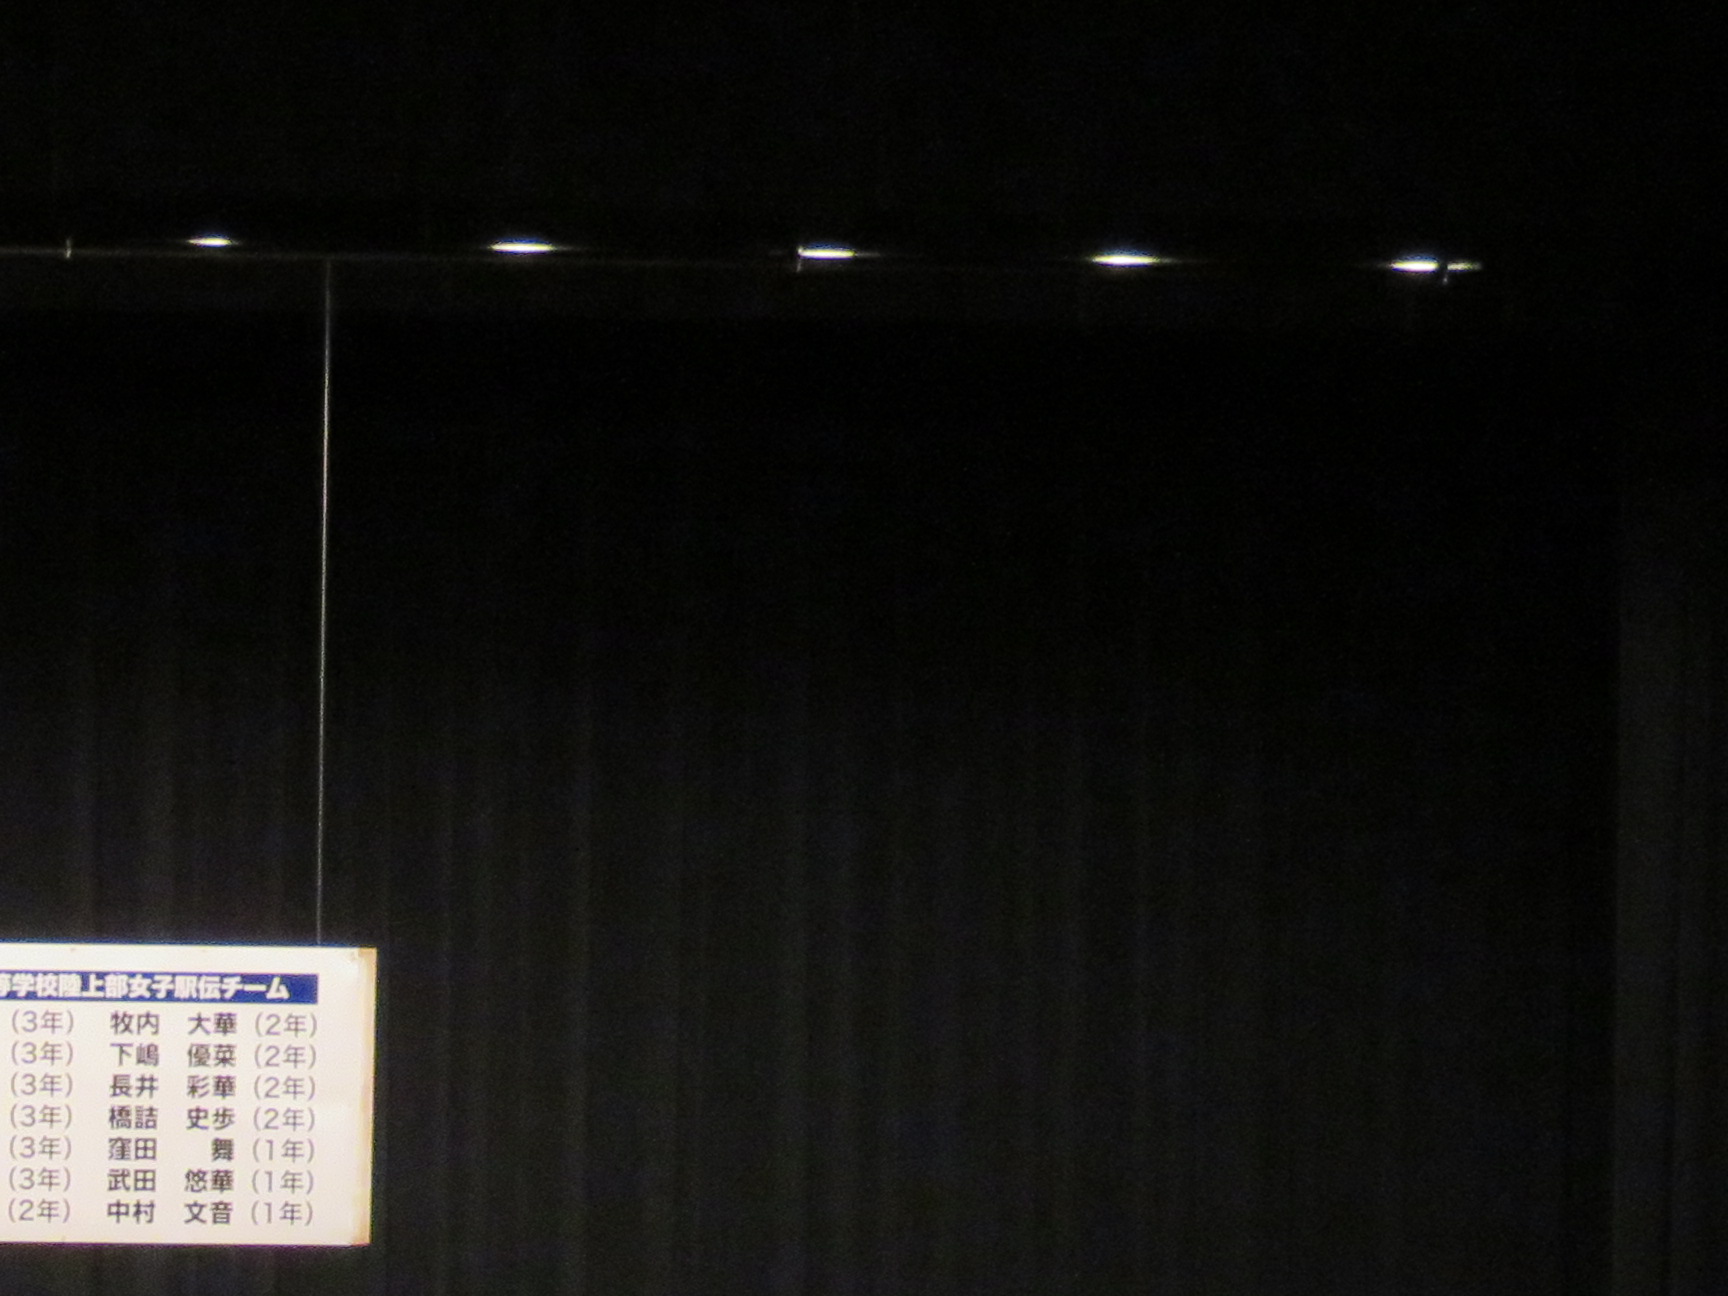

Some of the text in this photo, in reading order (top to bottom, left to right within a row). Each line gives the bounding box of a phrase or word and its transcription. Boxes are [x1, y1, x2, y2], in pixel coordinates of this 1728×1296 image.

[110, 1074, 158, 1098] 長井
[108, 1169, 156, 1192] 武田
[107, 1199, 155, 1223] 中村
